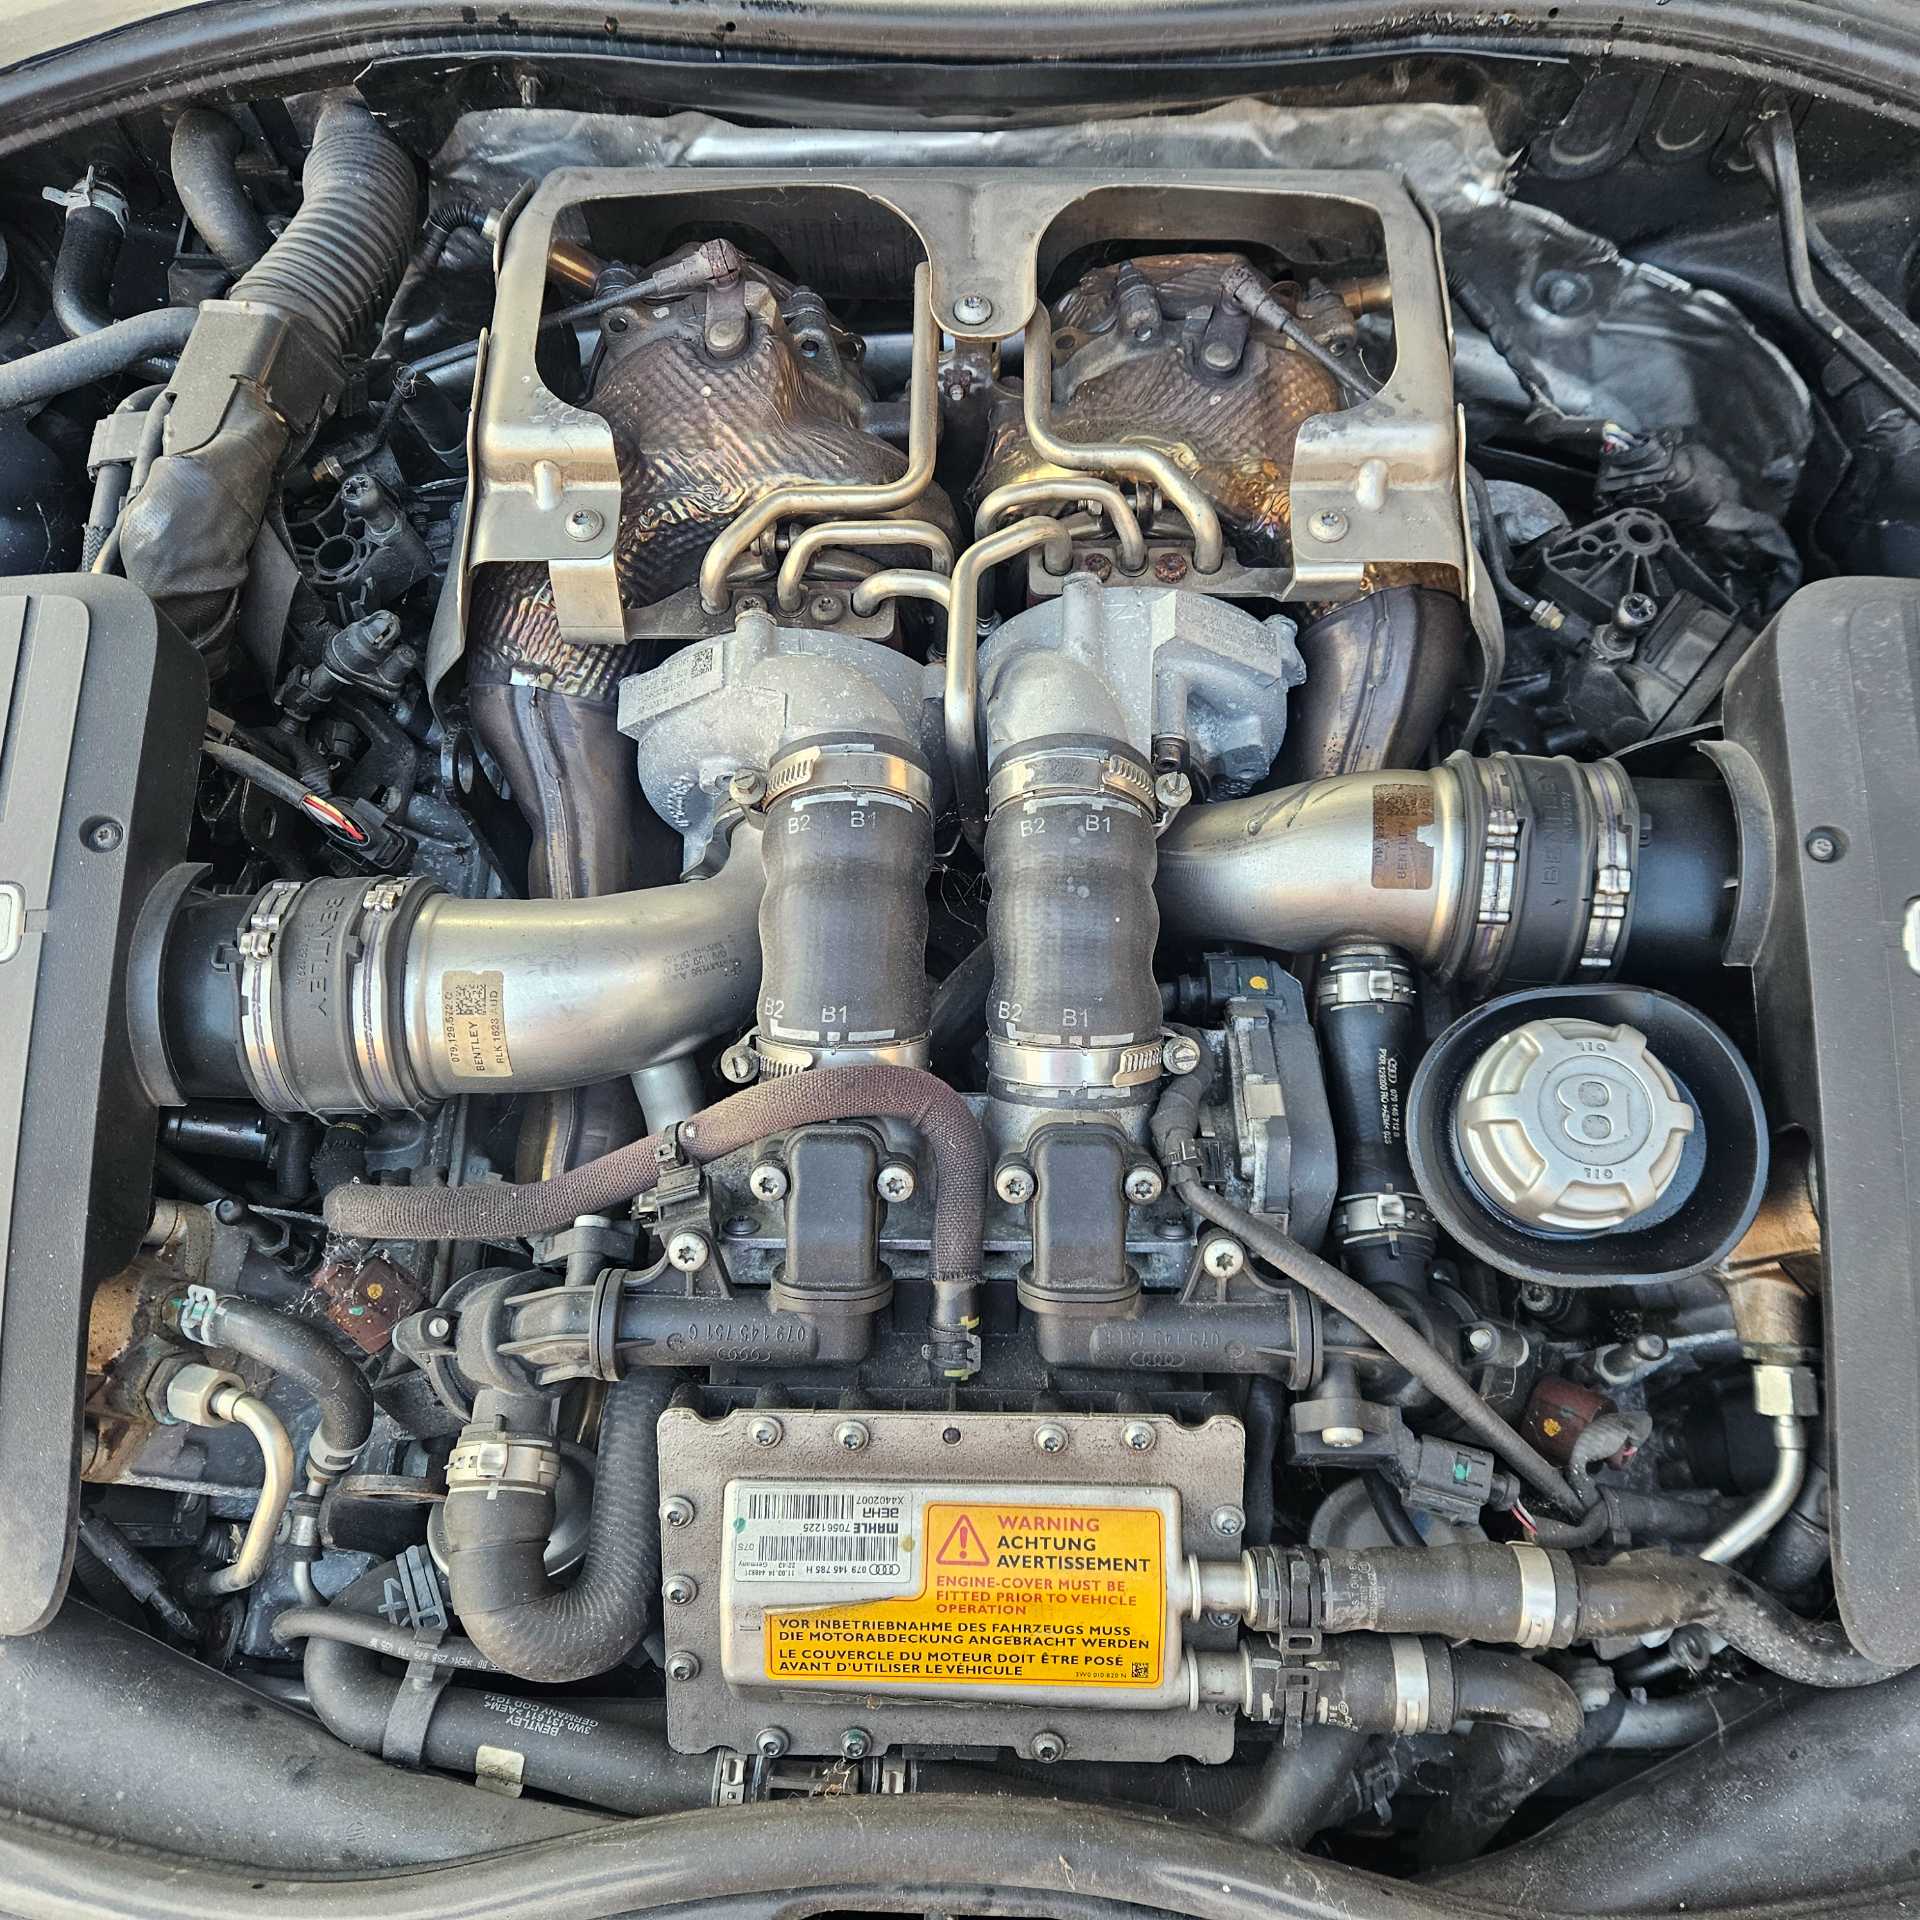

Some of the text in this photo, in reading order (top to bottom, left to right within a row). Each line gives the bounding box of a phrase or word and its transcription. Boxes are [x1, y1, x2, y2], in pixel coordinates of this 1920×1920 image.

[787, 810, 878, 834] B2 B1
[1019, 815, 1112, 837] B2 B1
[307, 895, 346, 1017] BENTLEY
[764, 997, 849, 1024] B2 B1
[998, 1000, 1090, 1028] B2 B1
[468, 1020, 486, 1072] BENTLEY
[1575, 1041, 1607, 1053] OIL
[1583, 1166, 1614, 1180] OIL
[856, 1495, 904, 1505] X4402007
[862, 1507, 899, 1519] BEHR
[803, 1522, 899, 1534] MAHLE 70561225
[997, 1514, 1100, 1532] WARNING
[996, 1535, 1097, 1552] ACHTUNG
[738, 1560, 768, 1568] Germany
[806, 1566, 813, 1574] H
[851, 1565, 867, 1575] 079
[996, 1554, 1151, 1573] AVERTISSEMENT
[936, 1575, 1126, 1593] ENGINE-COVER MUST BE
[936, 1590, 1138, 1607] FITTED PRIOR TO VEHICLE
[936, 1603, 1028, 1615] OPERATION
[778, 1619, 1131, 1636] VOR INBETRIEBNAHME DES FAHRZEUGS MUSS
[779, 1631, 1150, 1650] DIE MOTORABDECKUNG ANGEBRACHT WERDEN
[779, 1649, 1124, 1667] LE COUVERCLE DU MOTEUR DOIT ÊTRE POSÉ
[779, 1661, 1023, 1677] AVANT D'UTILISER LE VÉHICULE
[525, 1709, 544, 1722] 611
[541, 1707, 599, 1728] GERMANY
[505, 1714, 560, 1737] BENTLEY
